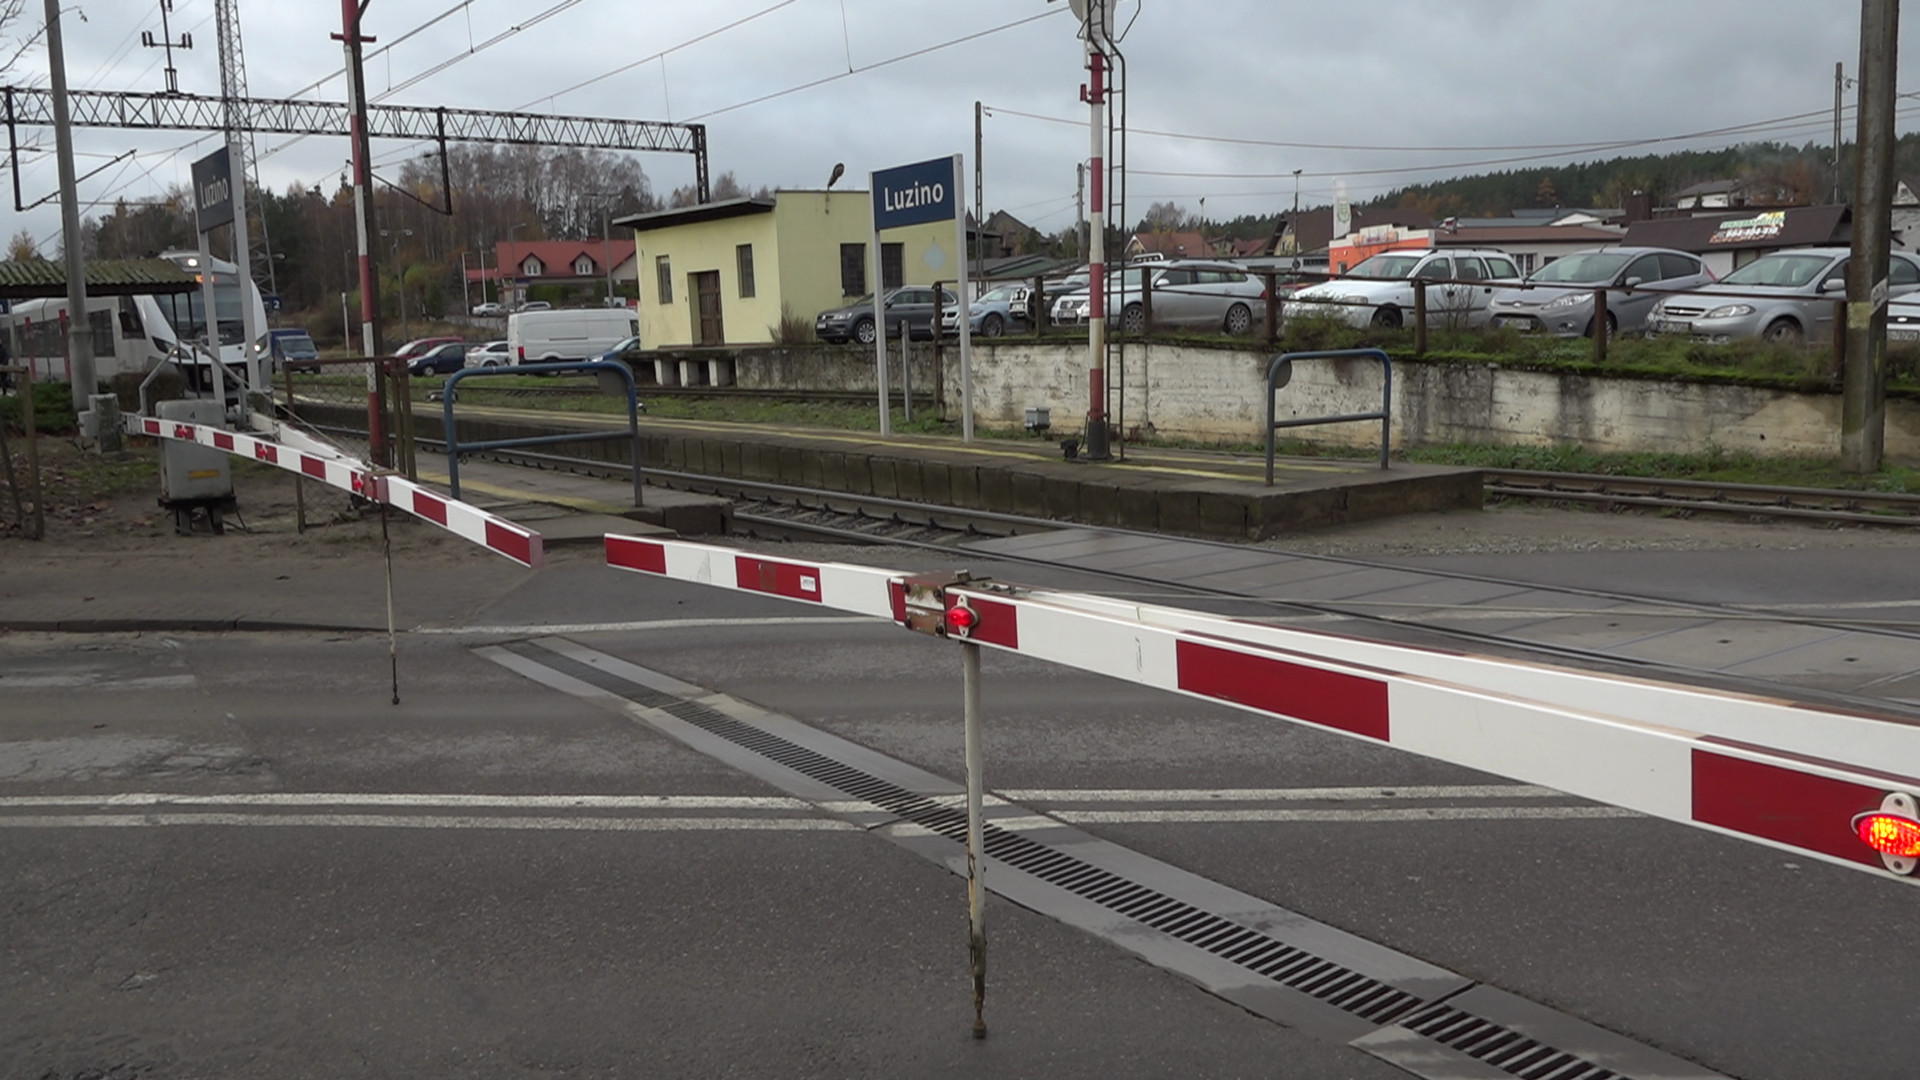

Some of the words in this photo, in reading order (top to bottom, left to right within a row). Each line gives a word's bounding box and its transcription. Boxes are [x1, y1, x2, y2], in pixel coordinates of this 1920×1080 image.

[200, 175, 229, 209] Luzino
[884, 181, 944, 212] Luzino
[273, 299, 281, 309] 2
